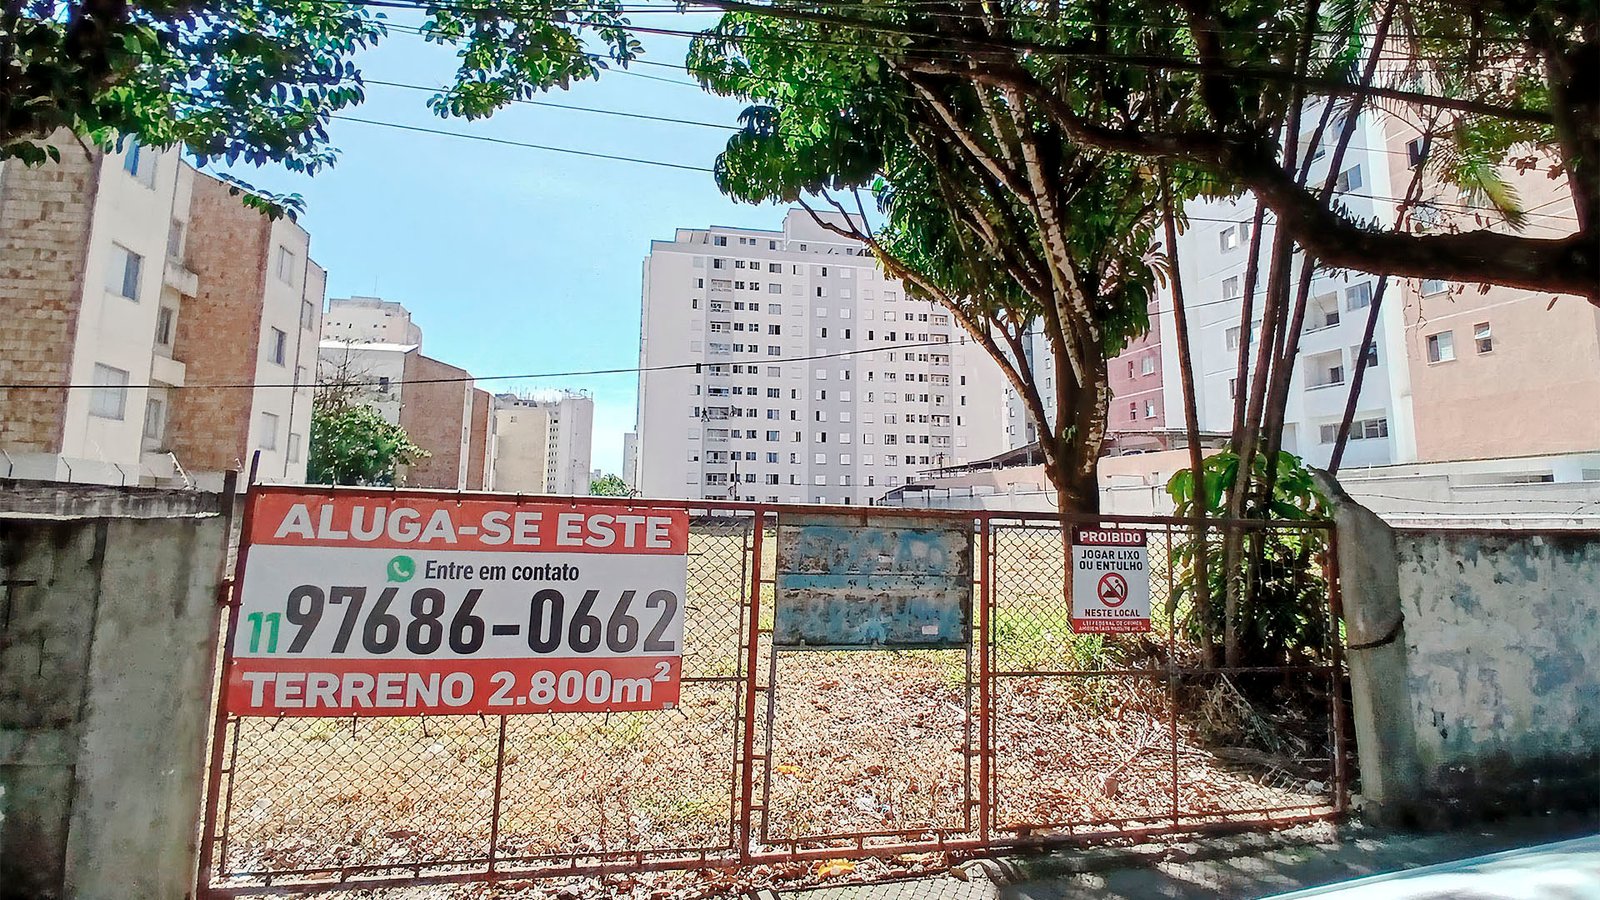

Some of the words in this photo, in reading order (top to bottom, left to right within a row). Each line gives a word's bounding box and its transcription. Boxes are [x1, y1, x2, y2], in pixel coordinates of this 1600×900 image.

[274, 504, 541, 546] ALUGA-SE
[556, 513, 672, 549] ESTE
[1079, 531, 1141, 543] PROIBIDO
[1081, 550, 1115, 560] JOGAR
[1118, 550, 1140, 560] LIXO
[424, 560, 474, 581] Entre
[479, 565, 506, 581] em
[511, 564, 580, 582] contato
[1079, 561, 1093, 570] OU
[1096, 561, 1143, 571] ENTULHO
[248, 611, 281, 654] 11
[286, 584, 677, 655] 97686-0662
[1084, 608, 1112, 617] NESTE
[1114, 609, 1140, 617] LOCAL
[242, 671, 474, 709] TERRENO
